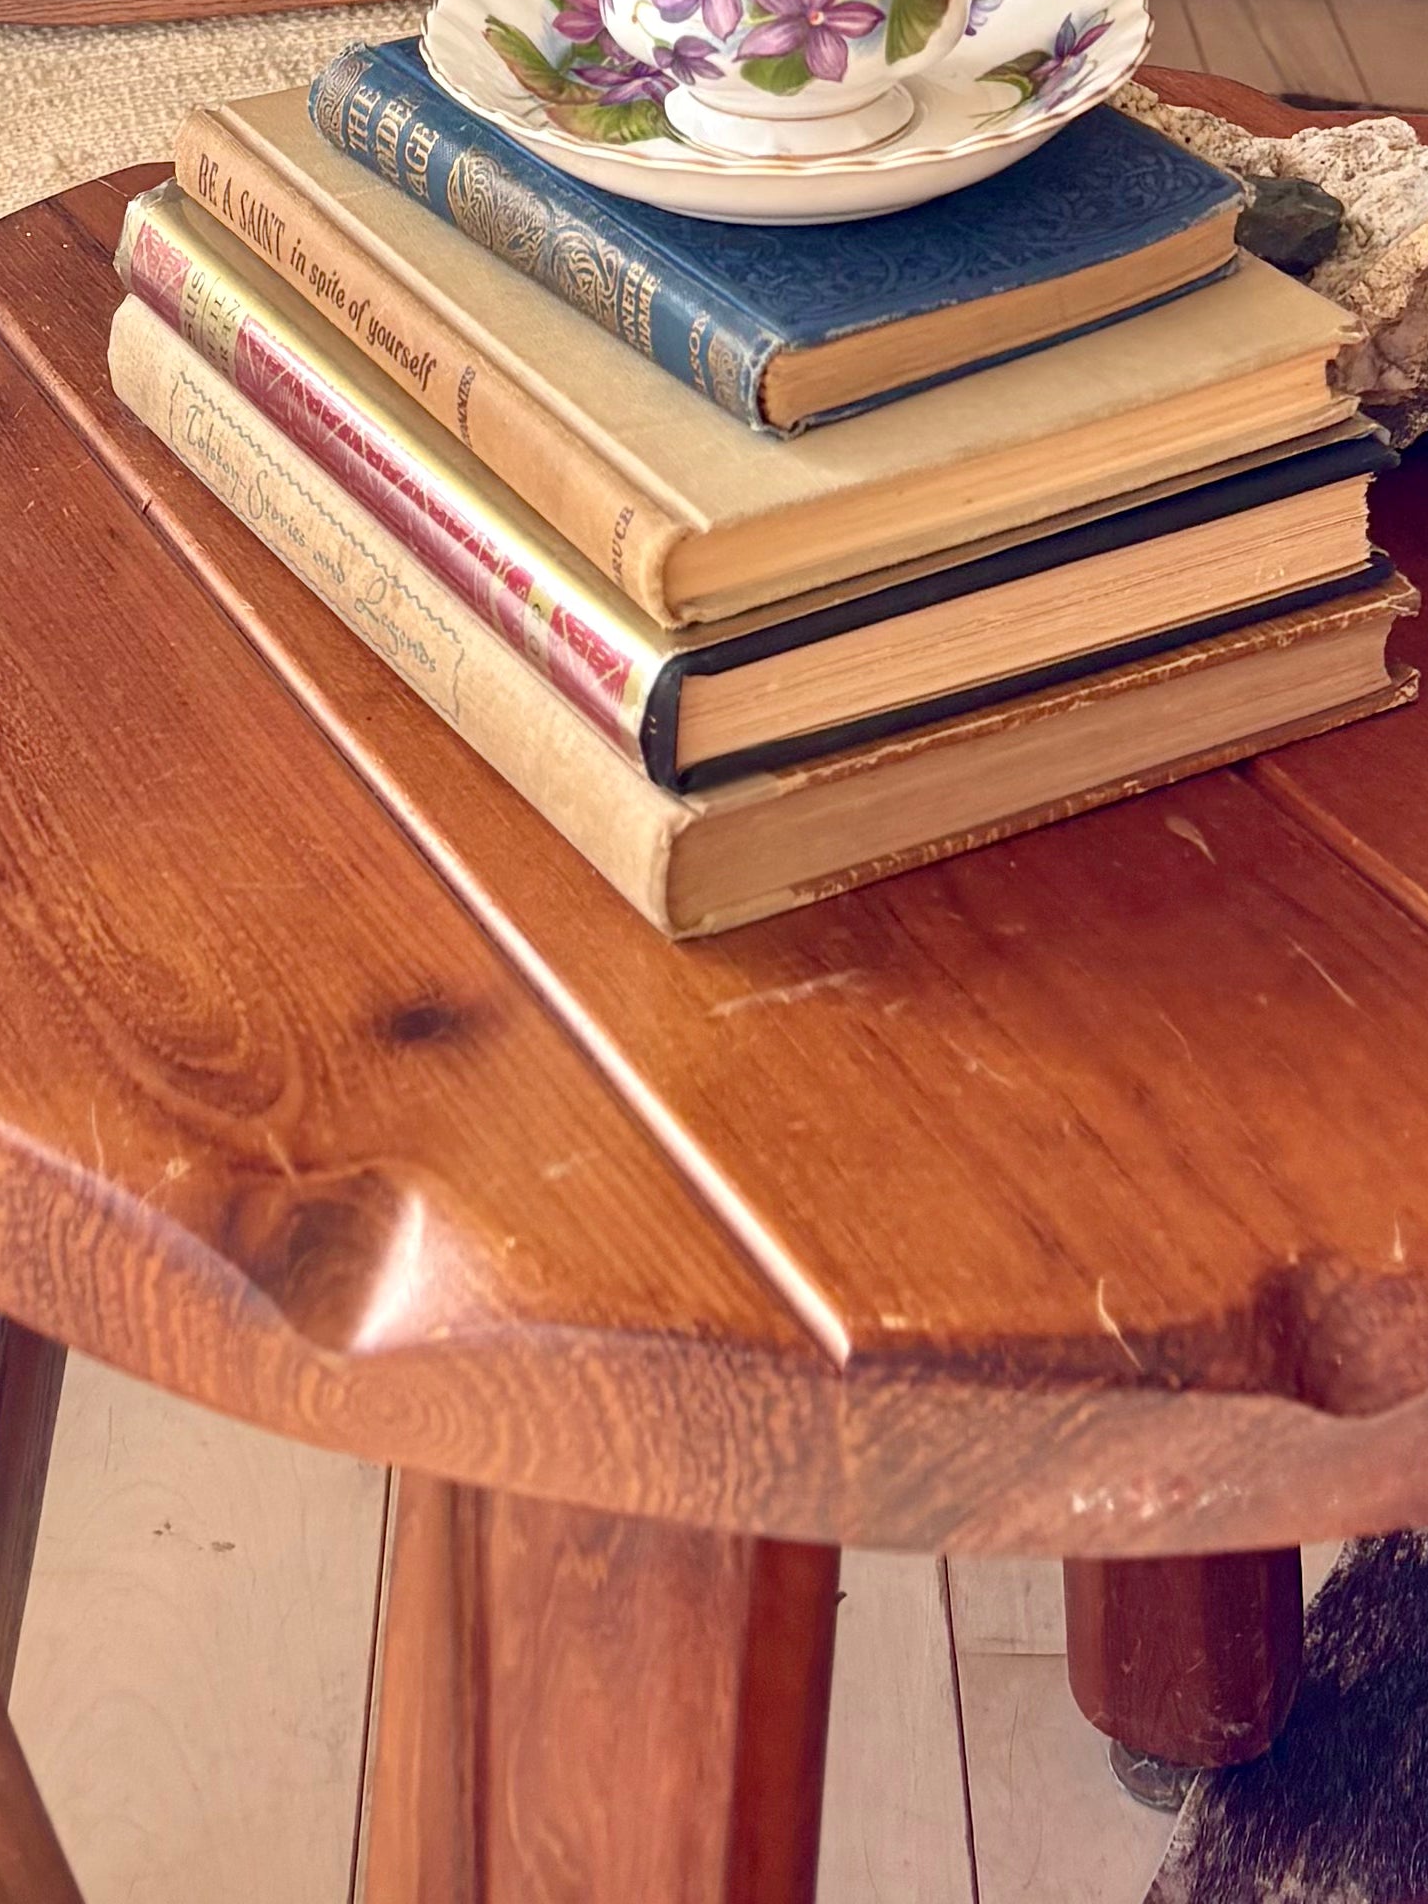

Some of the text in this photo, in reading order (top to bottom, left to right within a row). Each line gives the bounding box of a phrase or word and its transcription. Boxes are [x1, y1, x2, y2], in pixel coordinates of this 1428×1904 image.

[347, 85, 381, 154] THE
[405, 122, 440, 203] AGE
[184, 271, 206, 348] SUS
[198, 152, 438, 393] BE A SAINT in spite of yourself
[248, 470, 306, 548] Stories
[355, 576, 437, 673] Legends
